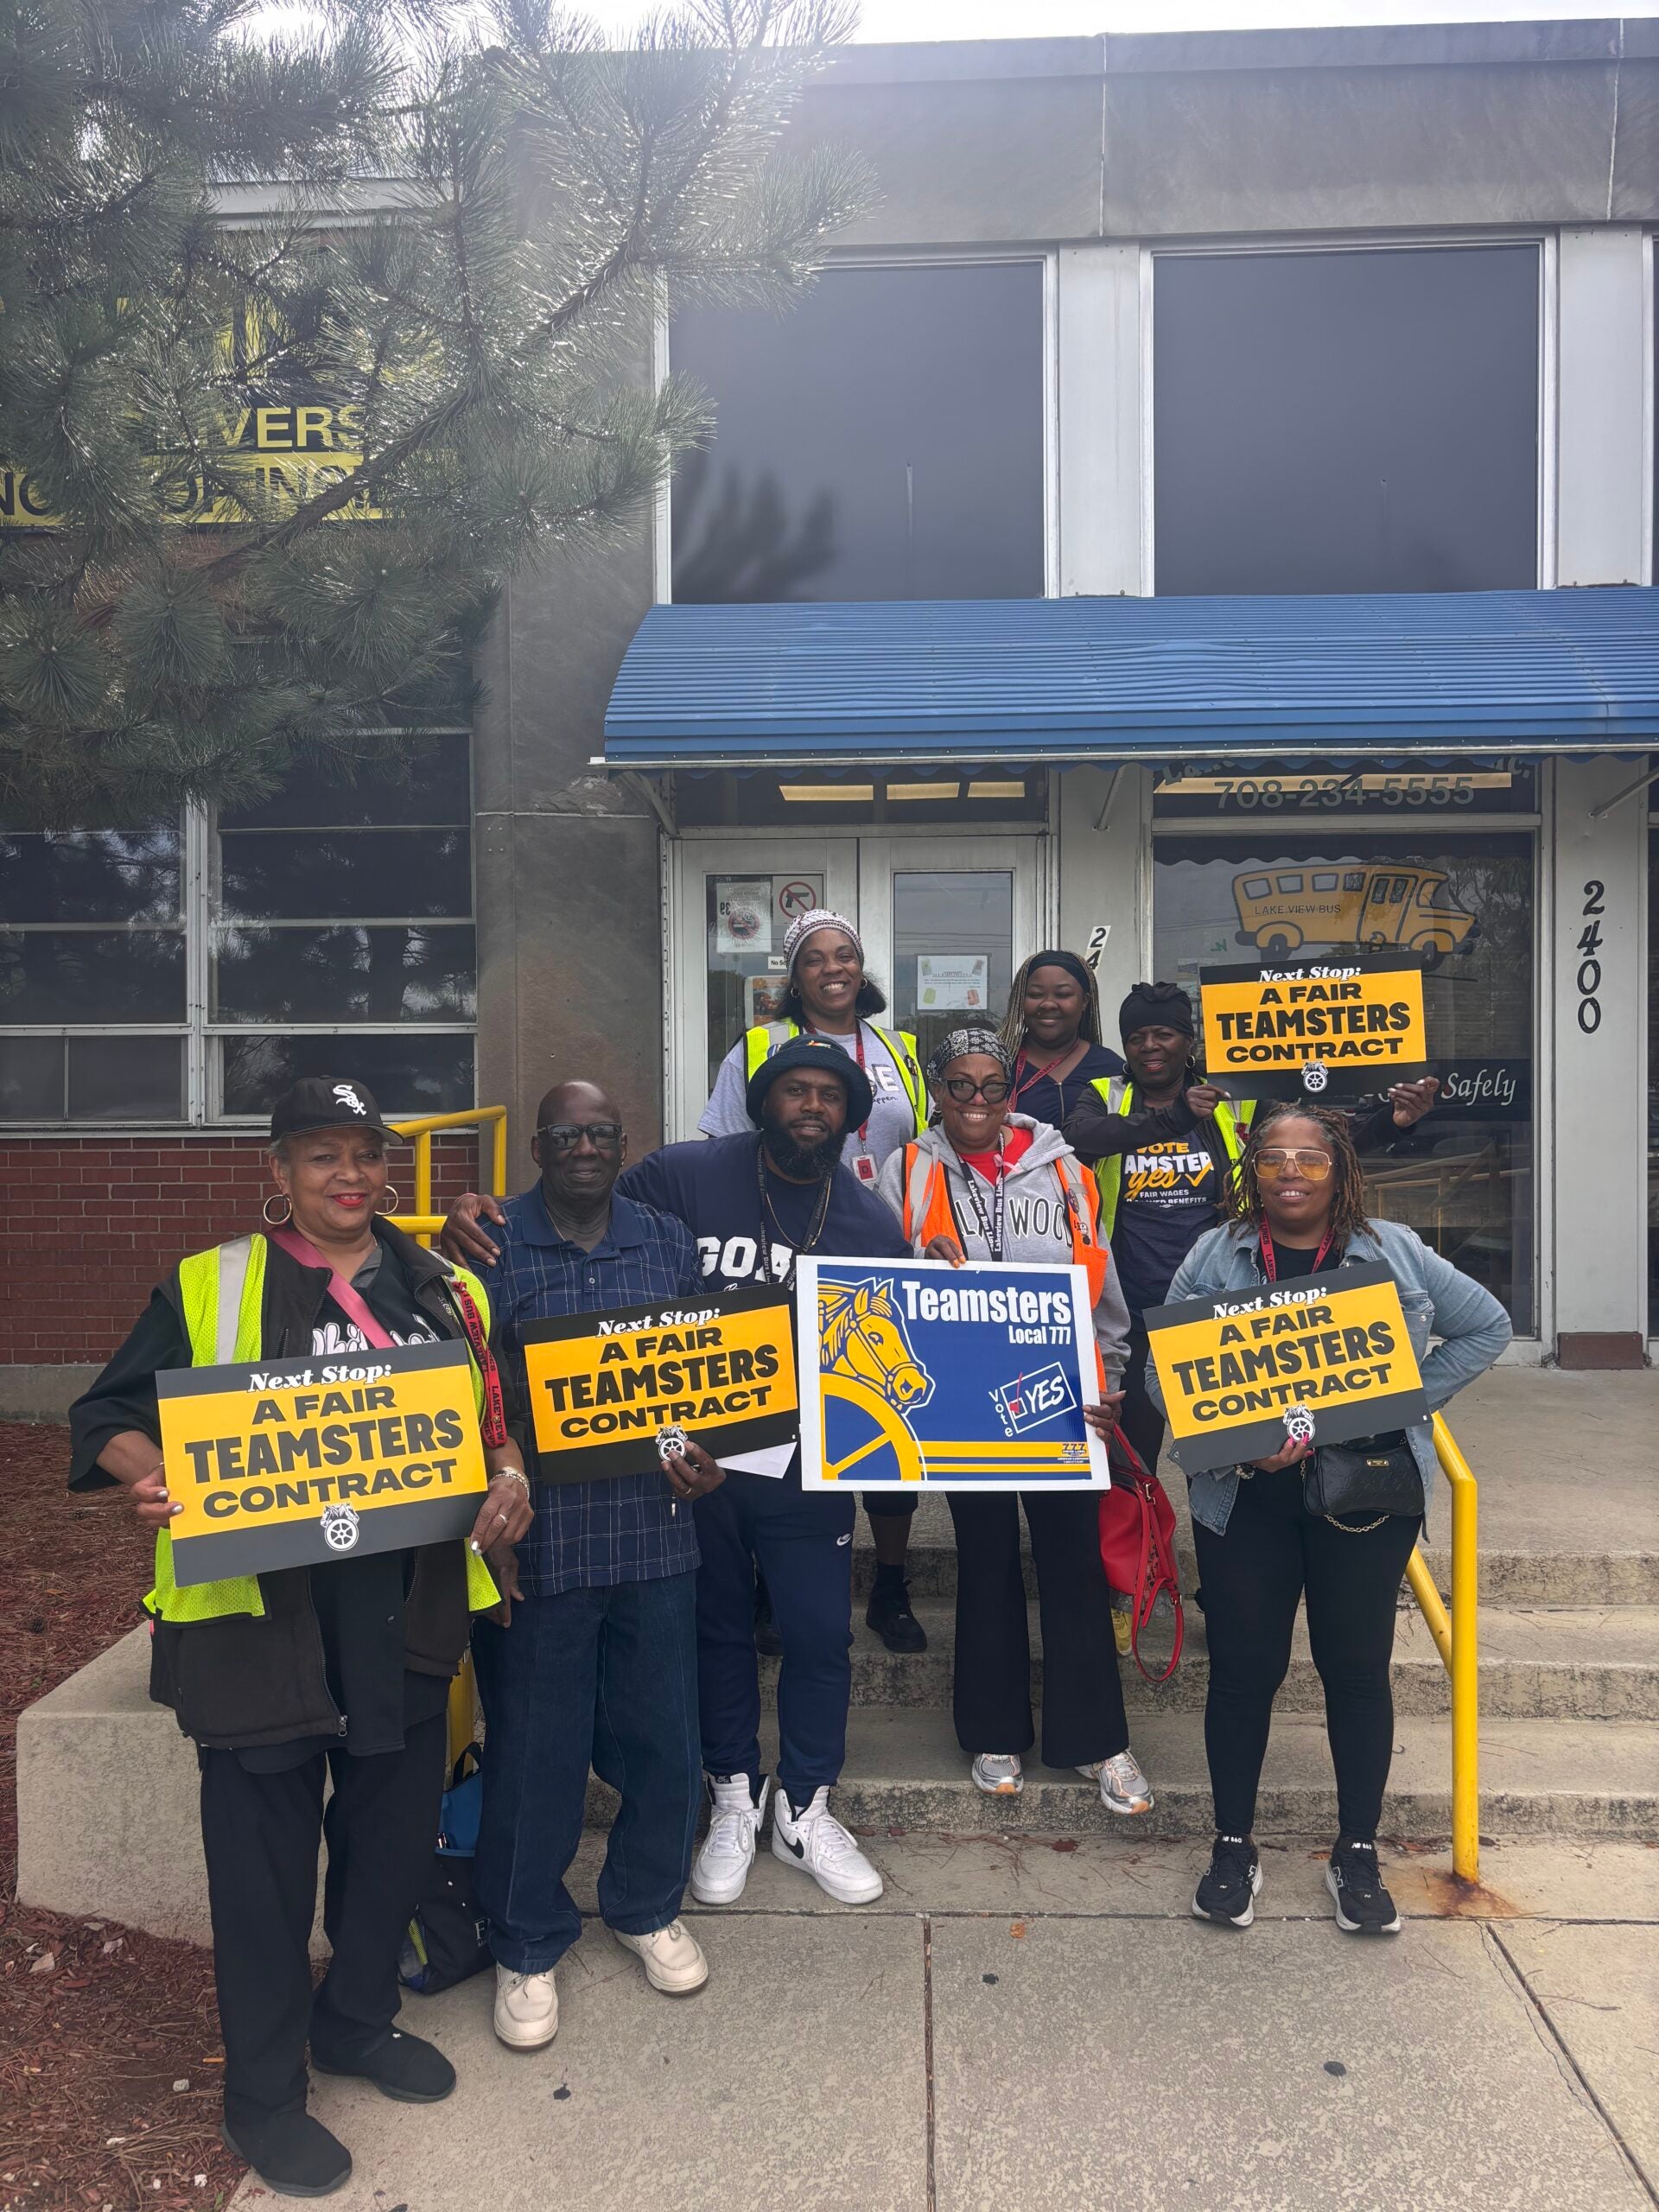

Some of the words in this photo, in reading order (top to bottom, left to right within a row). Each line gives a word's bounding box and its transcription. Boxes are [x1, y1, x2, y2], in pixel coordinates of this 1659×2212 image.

[1214, 776, 1474, 809] 708-234-5555
[1255, 906, 1284, 915] LAKE
[1287, 905, 1315, 914] VIEW
[1319, 904, 1341, 913] BUS
[1257, 967, 1305, 984] Next
[1308, 966, 1362, 982] Stop:
[1577, 880, 1605, 1033] 2400
[1259, 988, 1283, 1005] A
[1289, 982, 1362, 1003] FAIR
[1216, 1001, 1411, 1040] TEAMSTERS
[1226, 1037, 1403, 1063] CONTRACT
[333, 1084, 367, 1116] Sox
[1440, 1069, 1516, 1106] Safely
[1124, 1152, 1214, 1174] AMSTER
[1124, 1168, 1181, 1200] yes
[967, 1179, 985, 1215] Lakeview
[980, 1215, 989, 1230] Bus
[464, 1299, 475, 1319] BUS
[902, 1281, 1072, 1325] Teamsters
[1212, 1296, 1264, 1321] Next
[1269, 1287, 1327, 1308] Stop:
[596, 1316, 653, 1338] Next
[658, 1307, 721, 1329] Stop:
[1008, 1325, 1047, 1344] Local
[1049, 1326, 1071, 1344] 777
[1219, 1324, 1246, 1346] A
[1250, 1306, 1335, 1340] FAIR
[600, 1342, 628, 1364] A
[635, 1326, 723, 1358] FAIR
[1172, 1321, 1395, 1396] TEAMSTERS
[247, 1369, 313, 1394] Next
[321, 1363, 392, 1385] Stop:
[544, 1344, 779, 1413] TEAMSTERS
[1025, 1376, 1065, 1414] YES
[1192, 1363, 1392, 1422] CONTRACT
[251, 1399, 286, 1425] A
[294, 1386, 397, 1421] FAIR
[560, 1385, 772, 1439] CONTRACT
[184, 1409, 464, 1484] TEAMSTERS
[203, 1459, 458, 1518] CONTRACT
